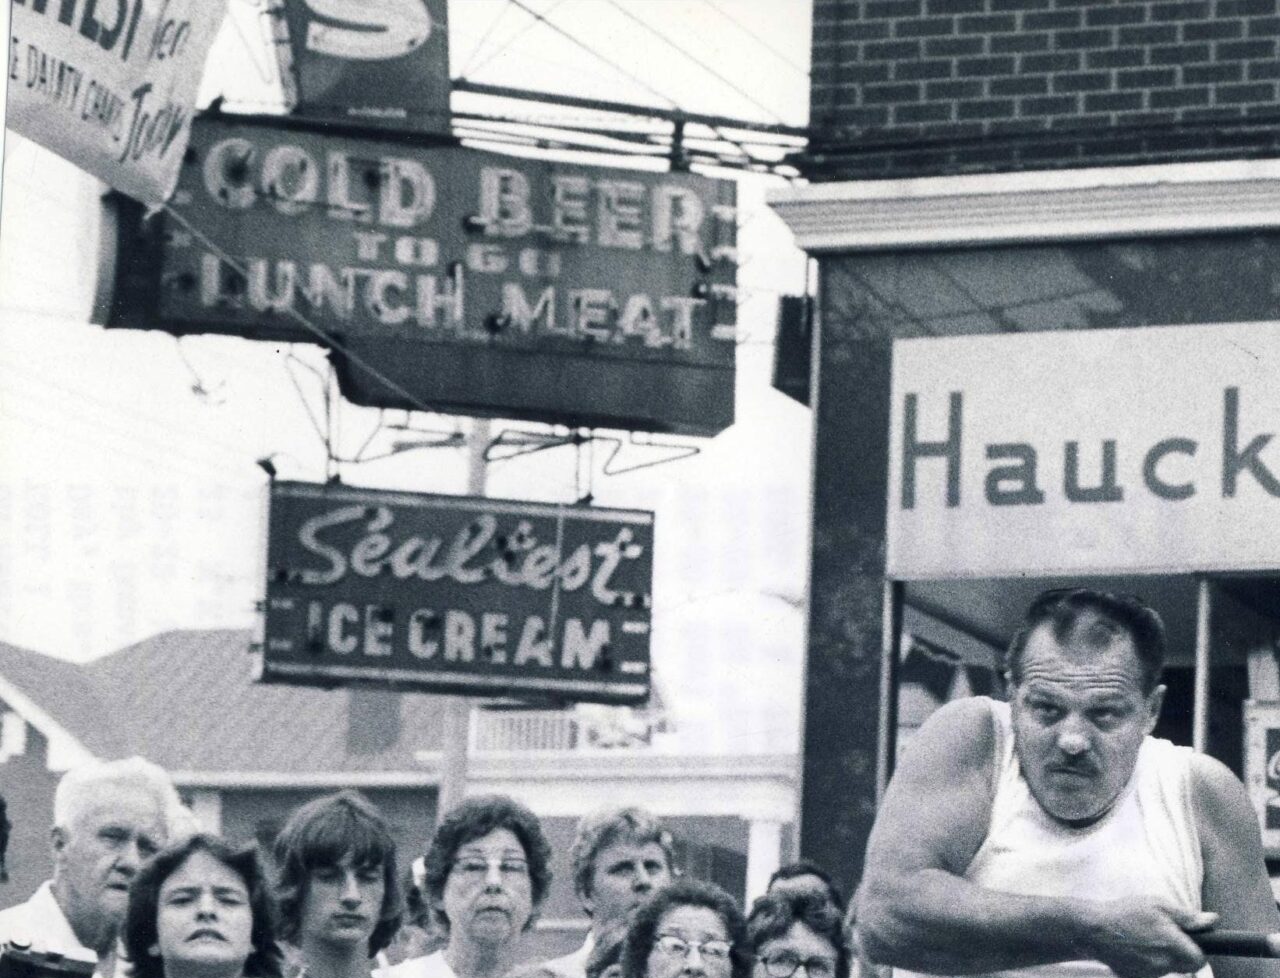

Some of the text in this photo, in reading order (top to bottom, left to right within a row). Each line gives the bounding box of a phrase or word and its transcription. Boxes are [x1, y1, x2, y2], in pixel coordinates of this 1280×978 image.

[203, 138, 704, 255] COLD BEER
[354, 231, 561, 277] TO GO
[202, 253, 707, 349] LUNCH MEAT
[307, 601, 611, 669] ICE CREAM
